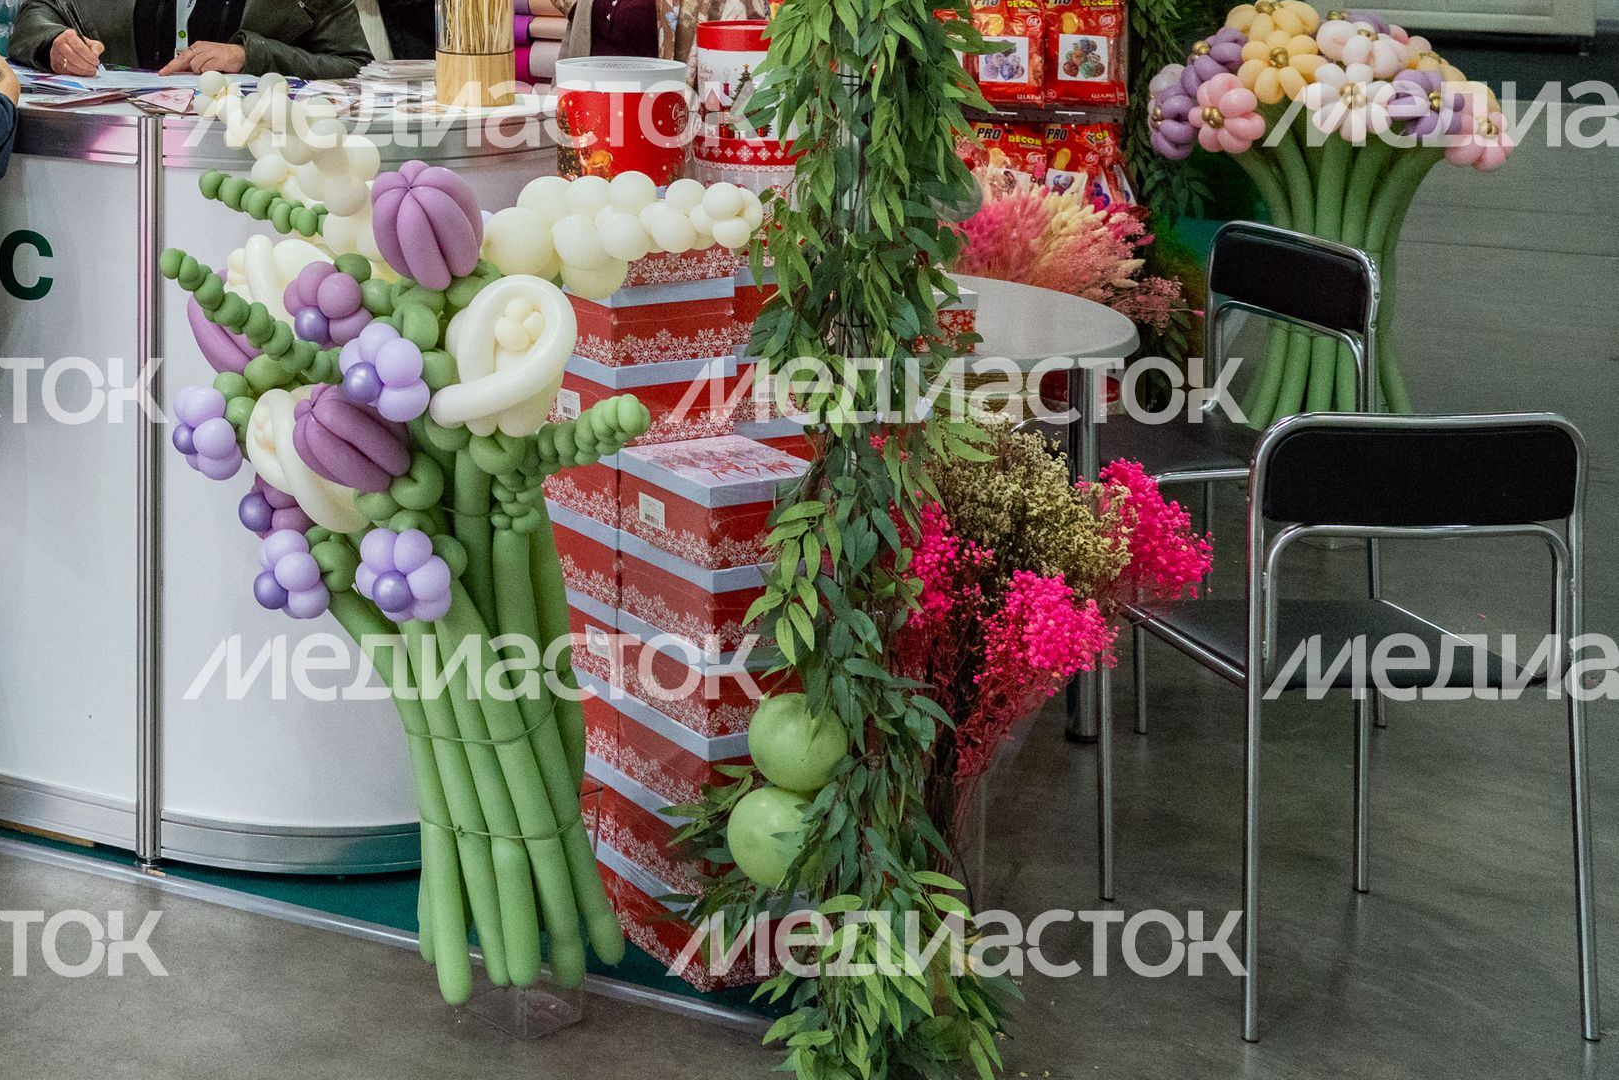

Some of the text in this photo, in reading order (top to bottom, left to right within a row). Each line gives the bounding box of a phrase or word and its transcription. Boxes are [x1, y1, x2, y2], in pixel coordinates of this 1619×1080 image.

[976, 127, 1042, 147] PRO DECOR
[1046, 127, 1069, 141] PRO
